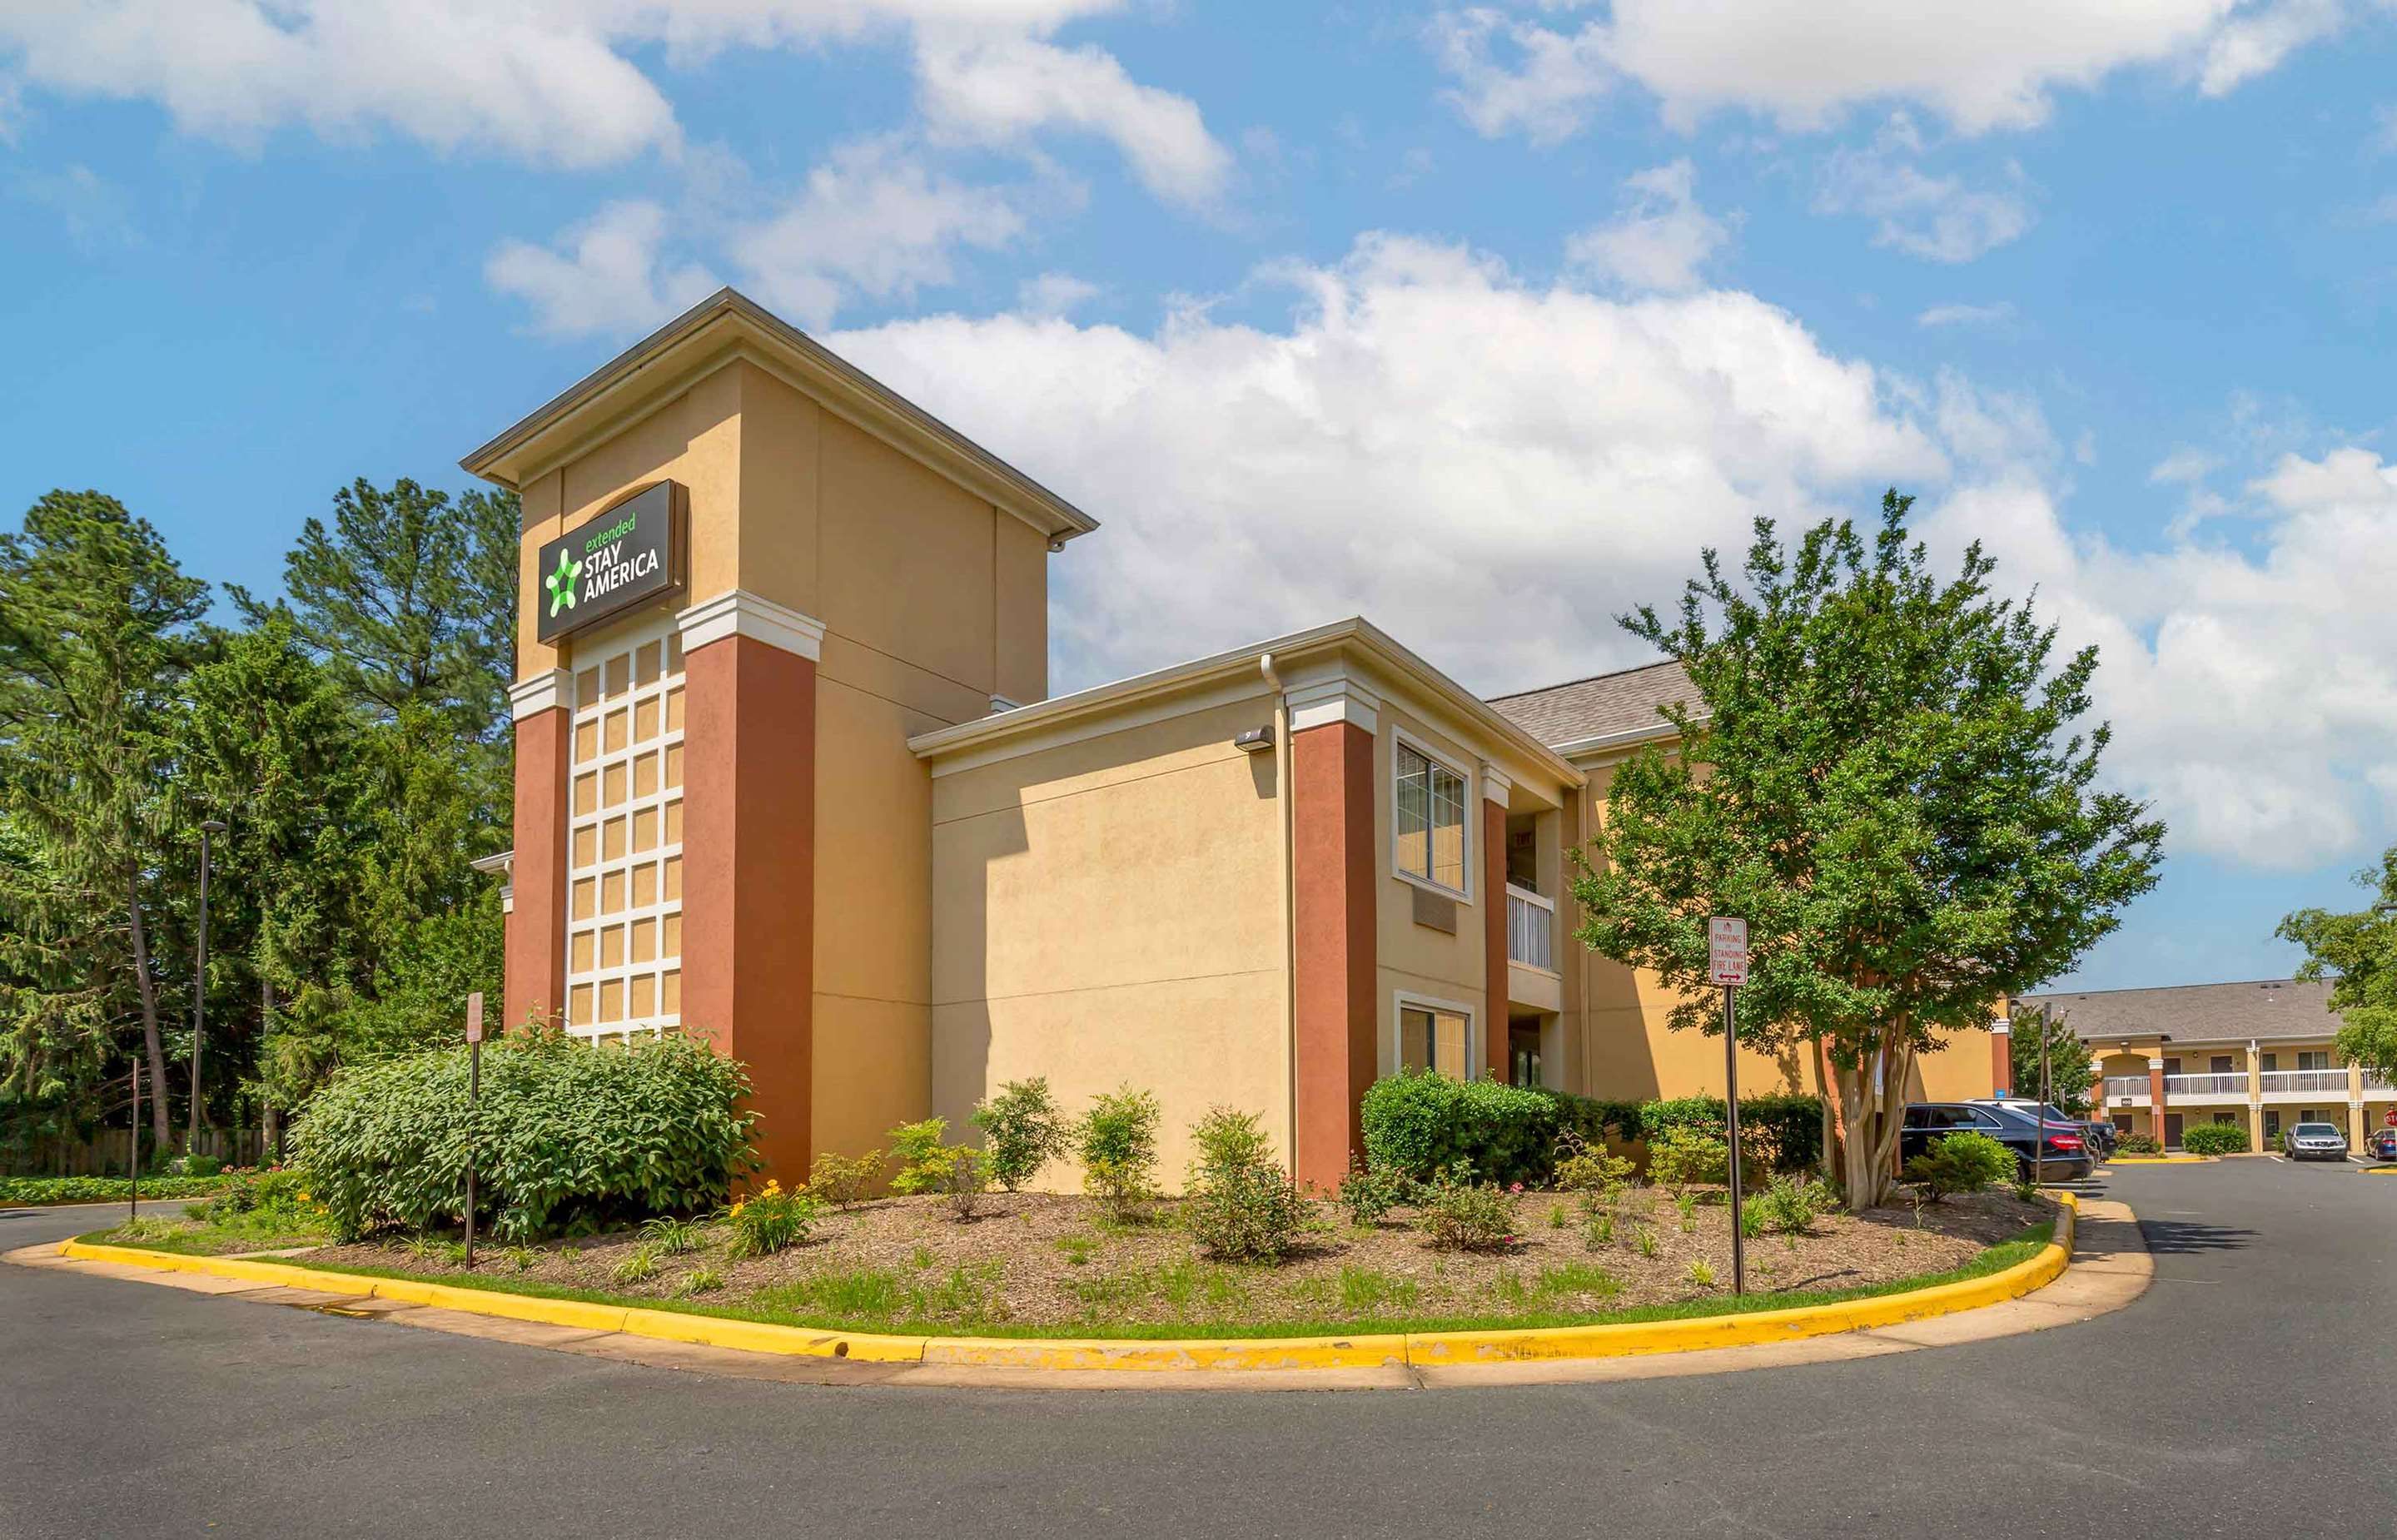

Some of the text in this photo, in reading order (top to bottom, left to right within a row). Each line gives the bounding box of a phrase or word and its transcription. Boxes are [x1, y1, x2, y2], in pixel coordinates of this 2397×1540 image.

[585, 513, 635, 553] extended
[584, 540, 622, 579] STAY
[584, 549, 659, 603] AMERICA
[1715, 933, 1741, 943] PARKING
[1713, 949, 1743, 959] STANDING
[1713, 959, 1744, 972] FIRE LANE
